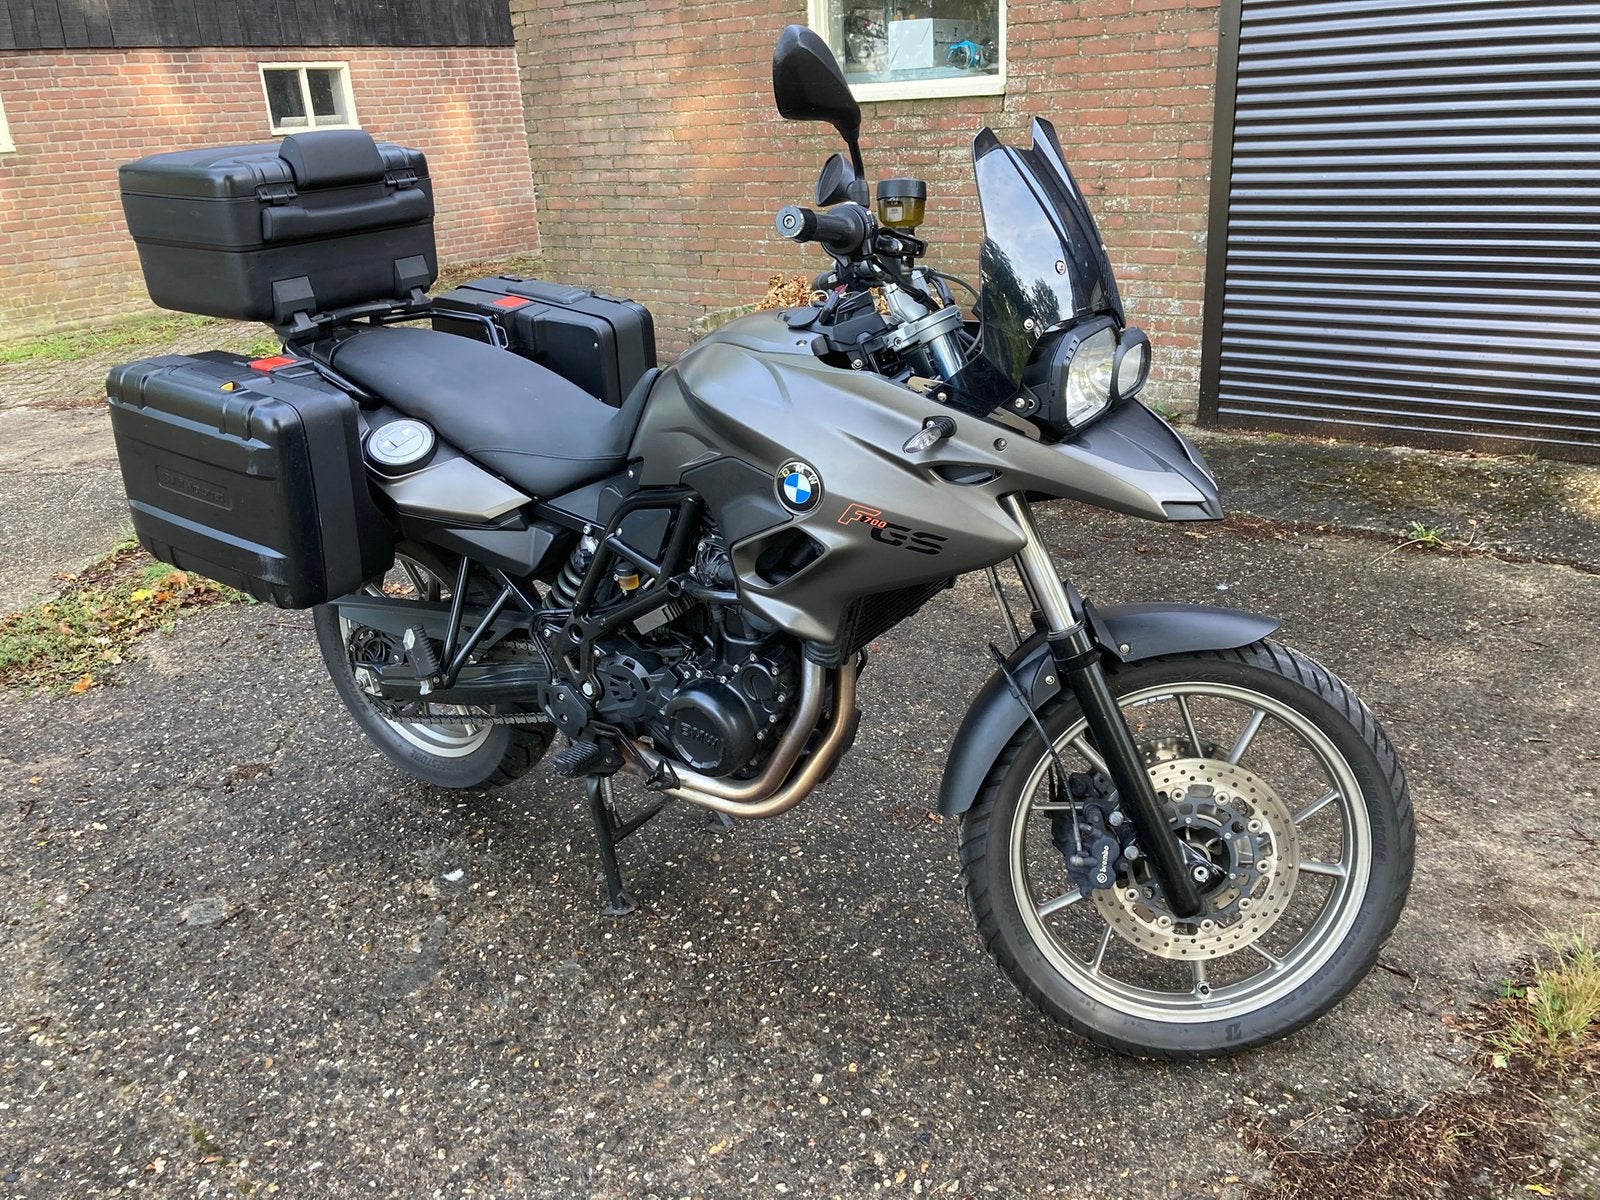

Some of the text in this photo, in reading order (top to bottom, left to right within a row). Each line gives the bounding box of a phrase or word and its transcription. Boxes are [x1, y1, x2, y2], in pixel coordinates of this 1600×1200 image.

[778, 464, 818, 485] BMW
[837, 503, 948, 555] F 700 GS
[680, 722, 720, 750] BMW
[1100, 845, 1109, 873] brembo
